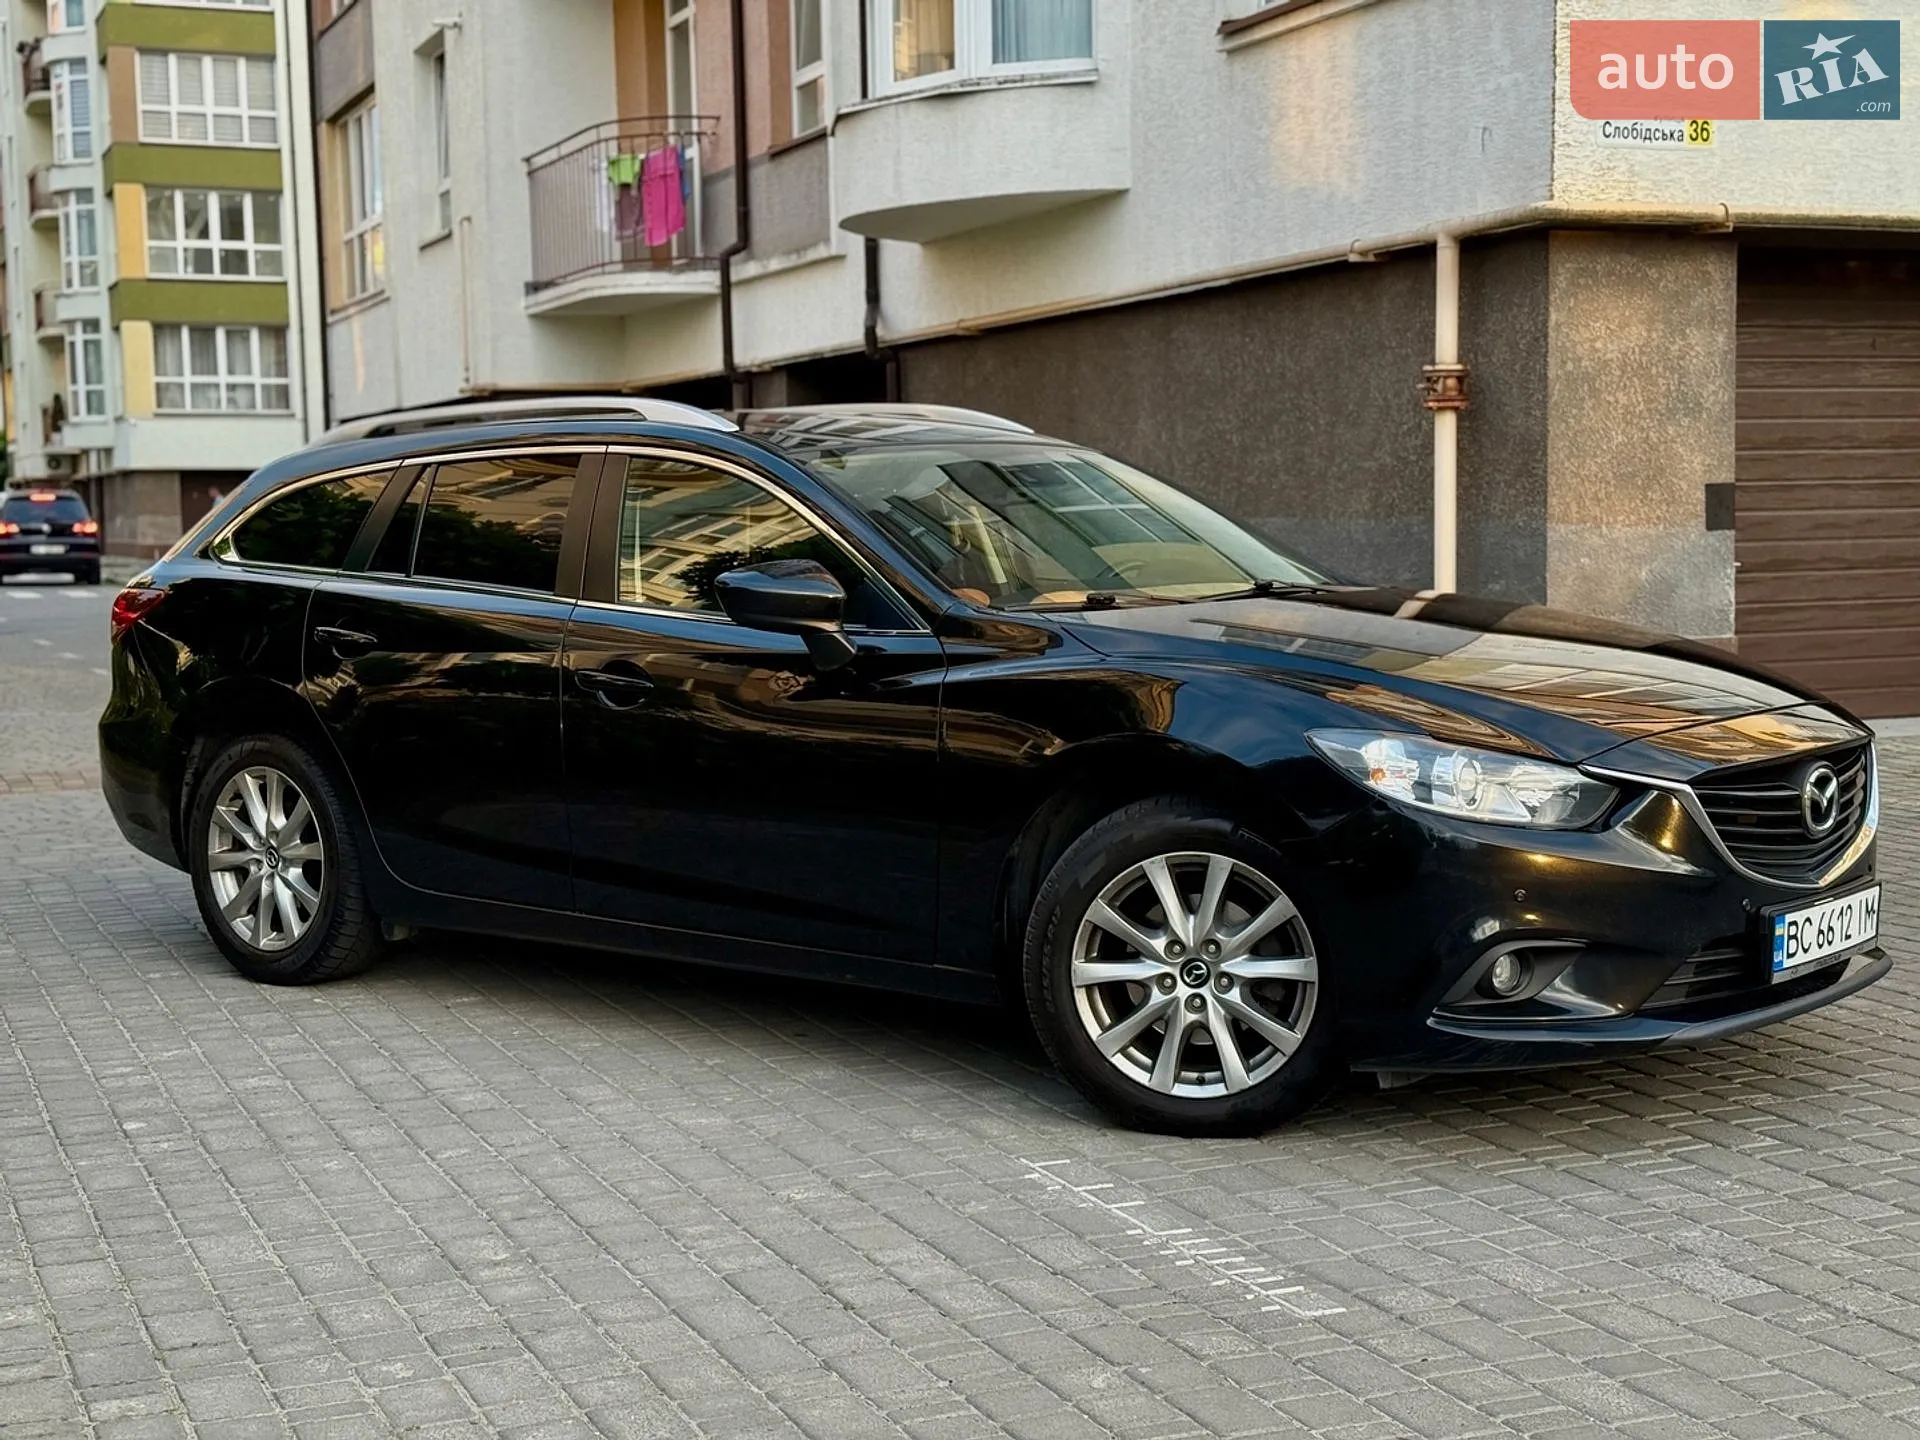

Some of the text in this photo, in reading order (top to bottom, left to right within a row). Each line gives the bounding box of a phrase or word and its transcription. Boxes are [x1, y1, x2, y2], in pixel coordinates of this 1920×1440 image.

[1602, 120, 1710, 143] Слобідська 36
[1787, 917, 1812, 959] BC
[1817, 904, 1852, 949] 6612
